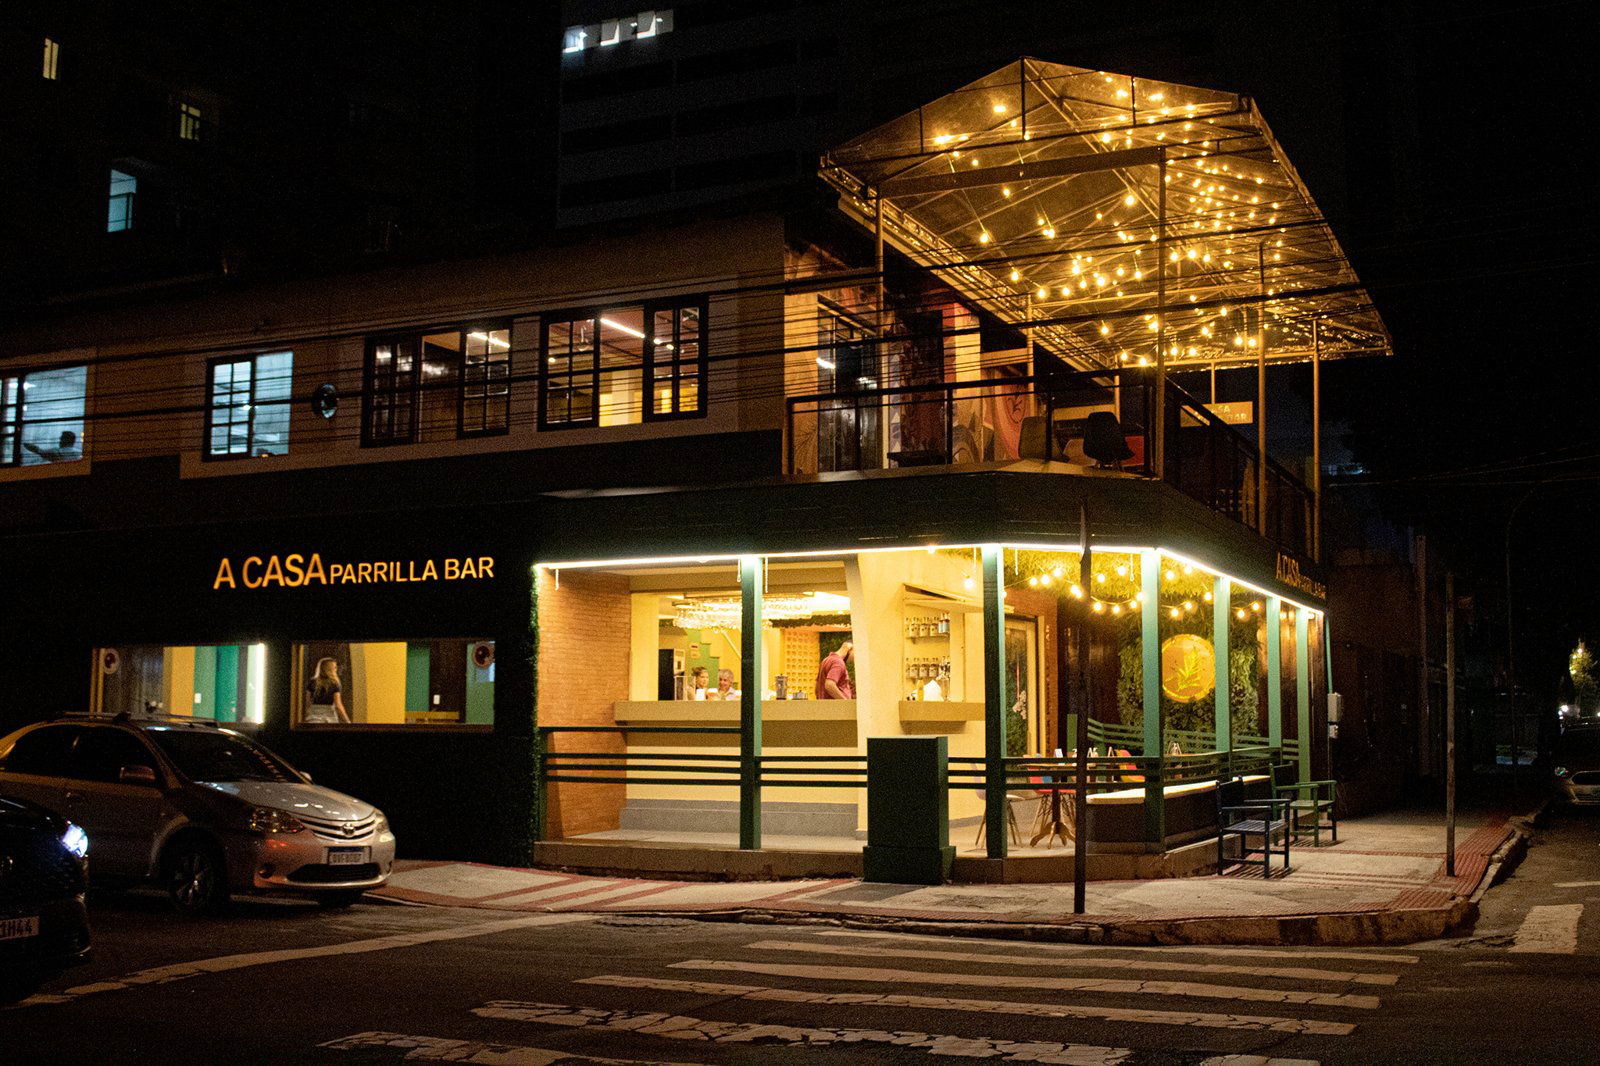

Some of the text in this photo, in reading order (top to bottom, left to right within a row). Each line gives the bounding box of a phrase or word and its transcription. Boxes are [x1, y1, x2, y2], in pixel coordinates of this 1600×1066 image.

[213, 553, 495, 589] A CASA PARRILLA BAR
